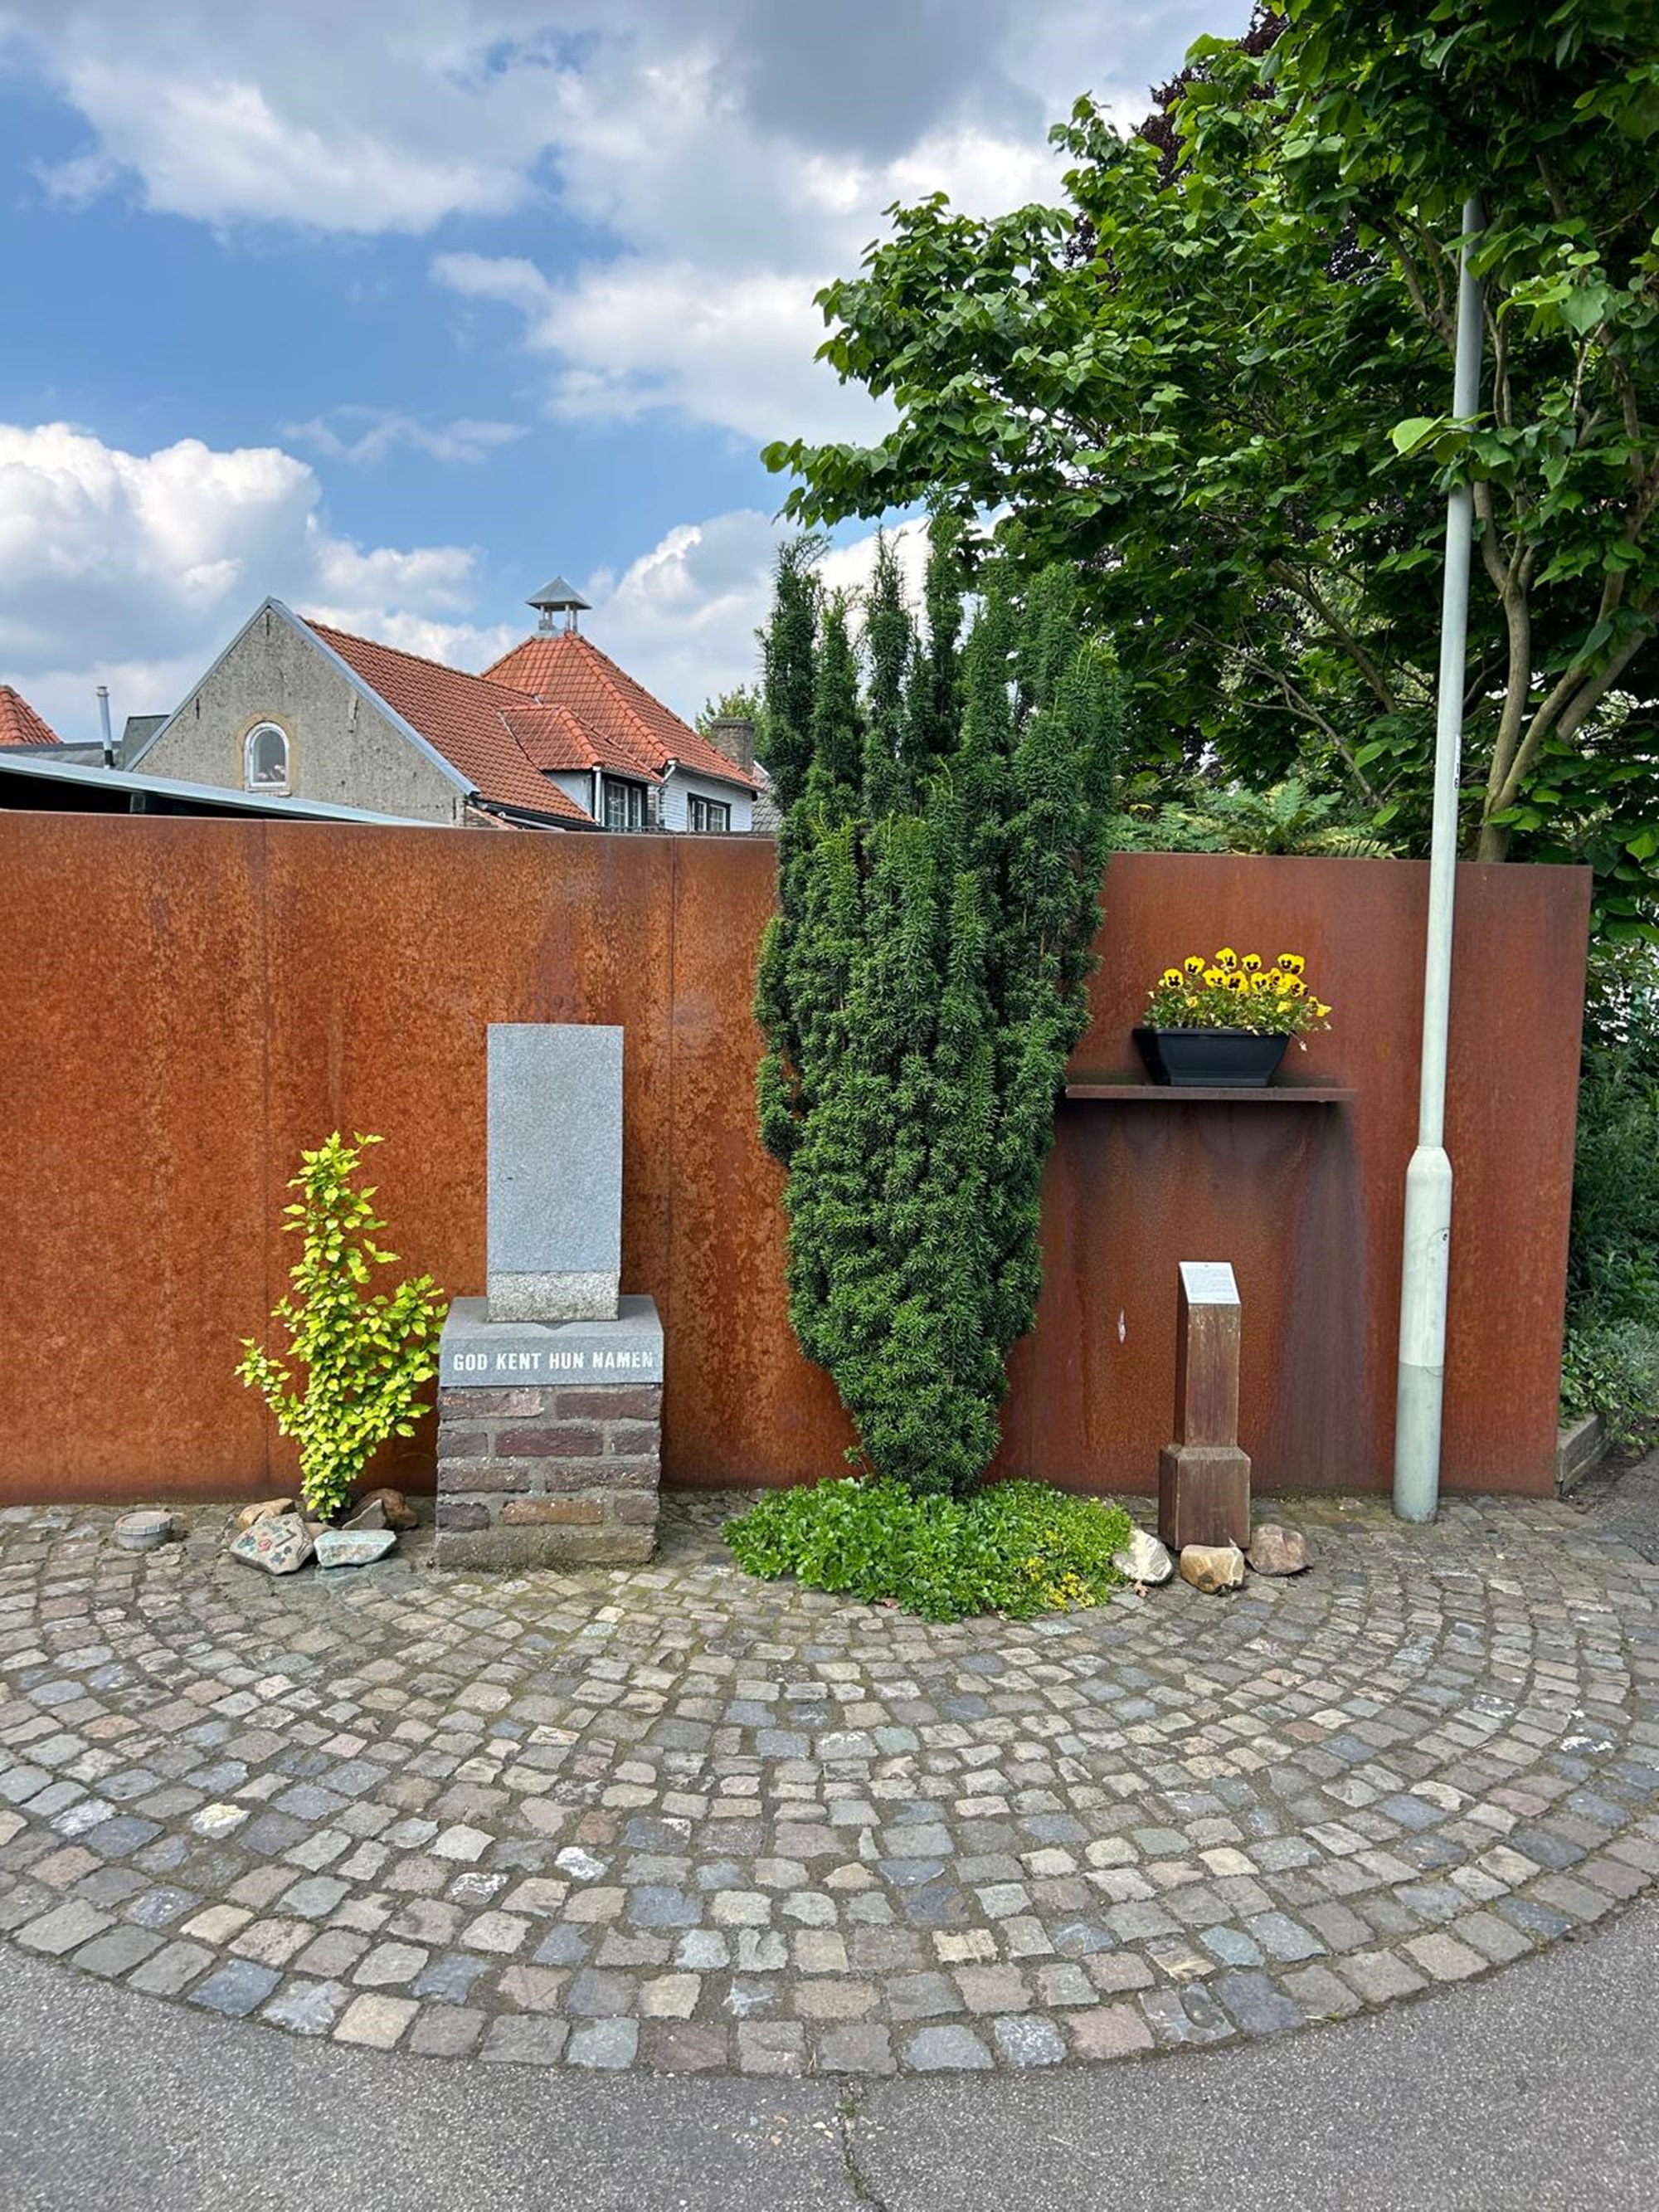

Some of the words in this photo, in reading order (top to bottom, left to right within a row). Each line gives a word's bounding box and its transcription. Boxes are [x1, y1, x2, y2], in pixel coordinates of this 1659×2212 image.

[453, 1353, 488, 1371] GOD
[496, 1352, 541, 1370] KENT
[549, 1352, 584, 1369] HUN
[592, 1351, 653, 1368] NAMEN
